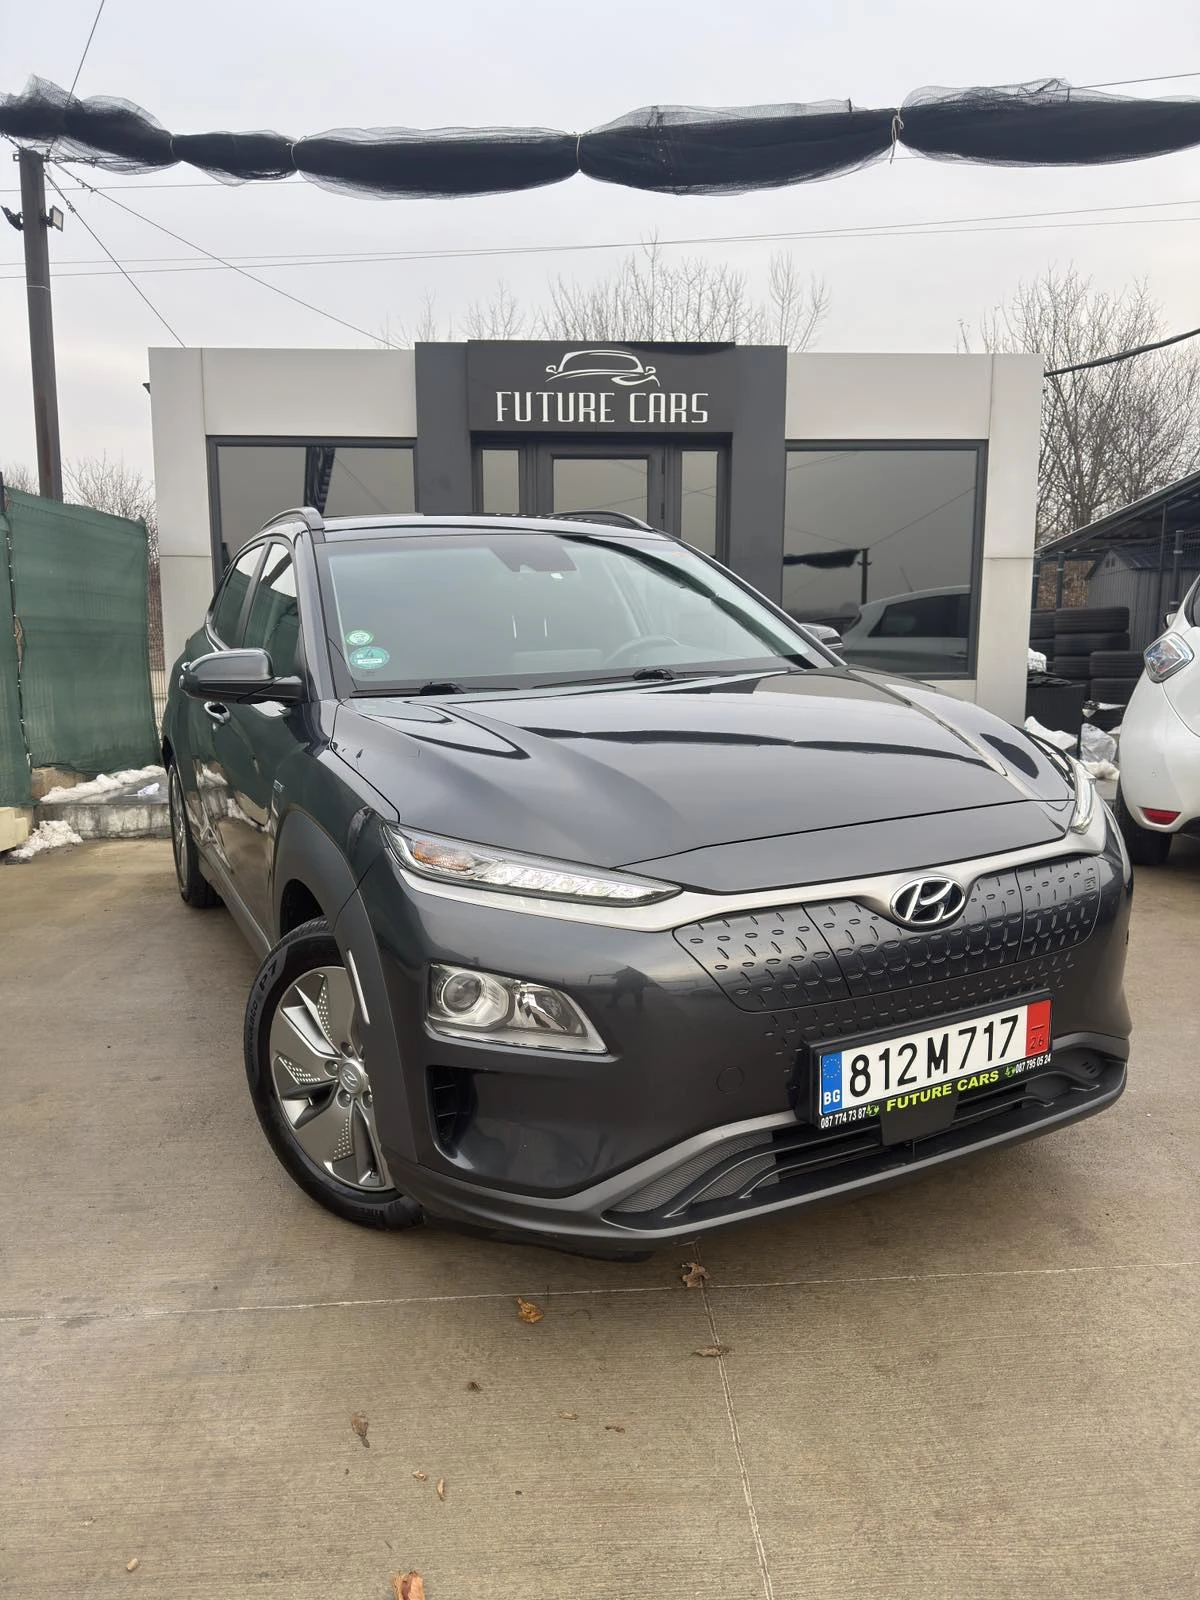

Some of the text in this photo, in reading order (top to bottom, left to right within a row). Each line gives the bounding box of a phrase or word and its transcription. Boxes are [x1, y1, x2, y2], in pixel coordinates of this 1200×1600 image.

[495, 391, 709, 423] FUTURE CARS
[850, 1014, 1019, 1098] 812M717
[823, 1088, 841, 1105] BG
[886, 1070, 999, 1112] FUTURE CARS
[820, 1106, 867, 1129] 087 774 73 87
